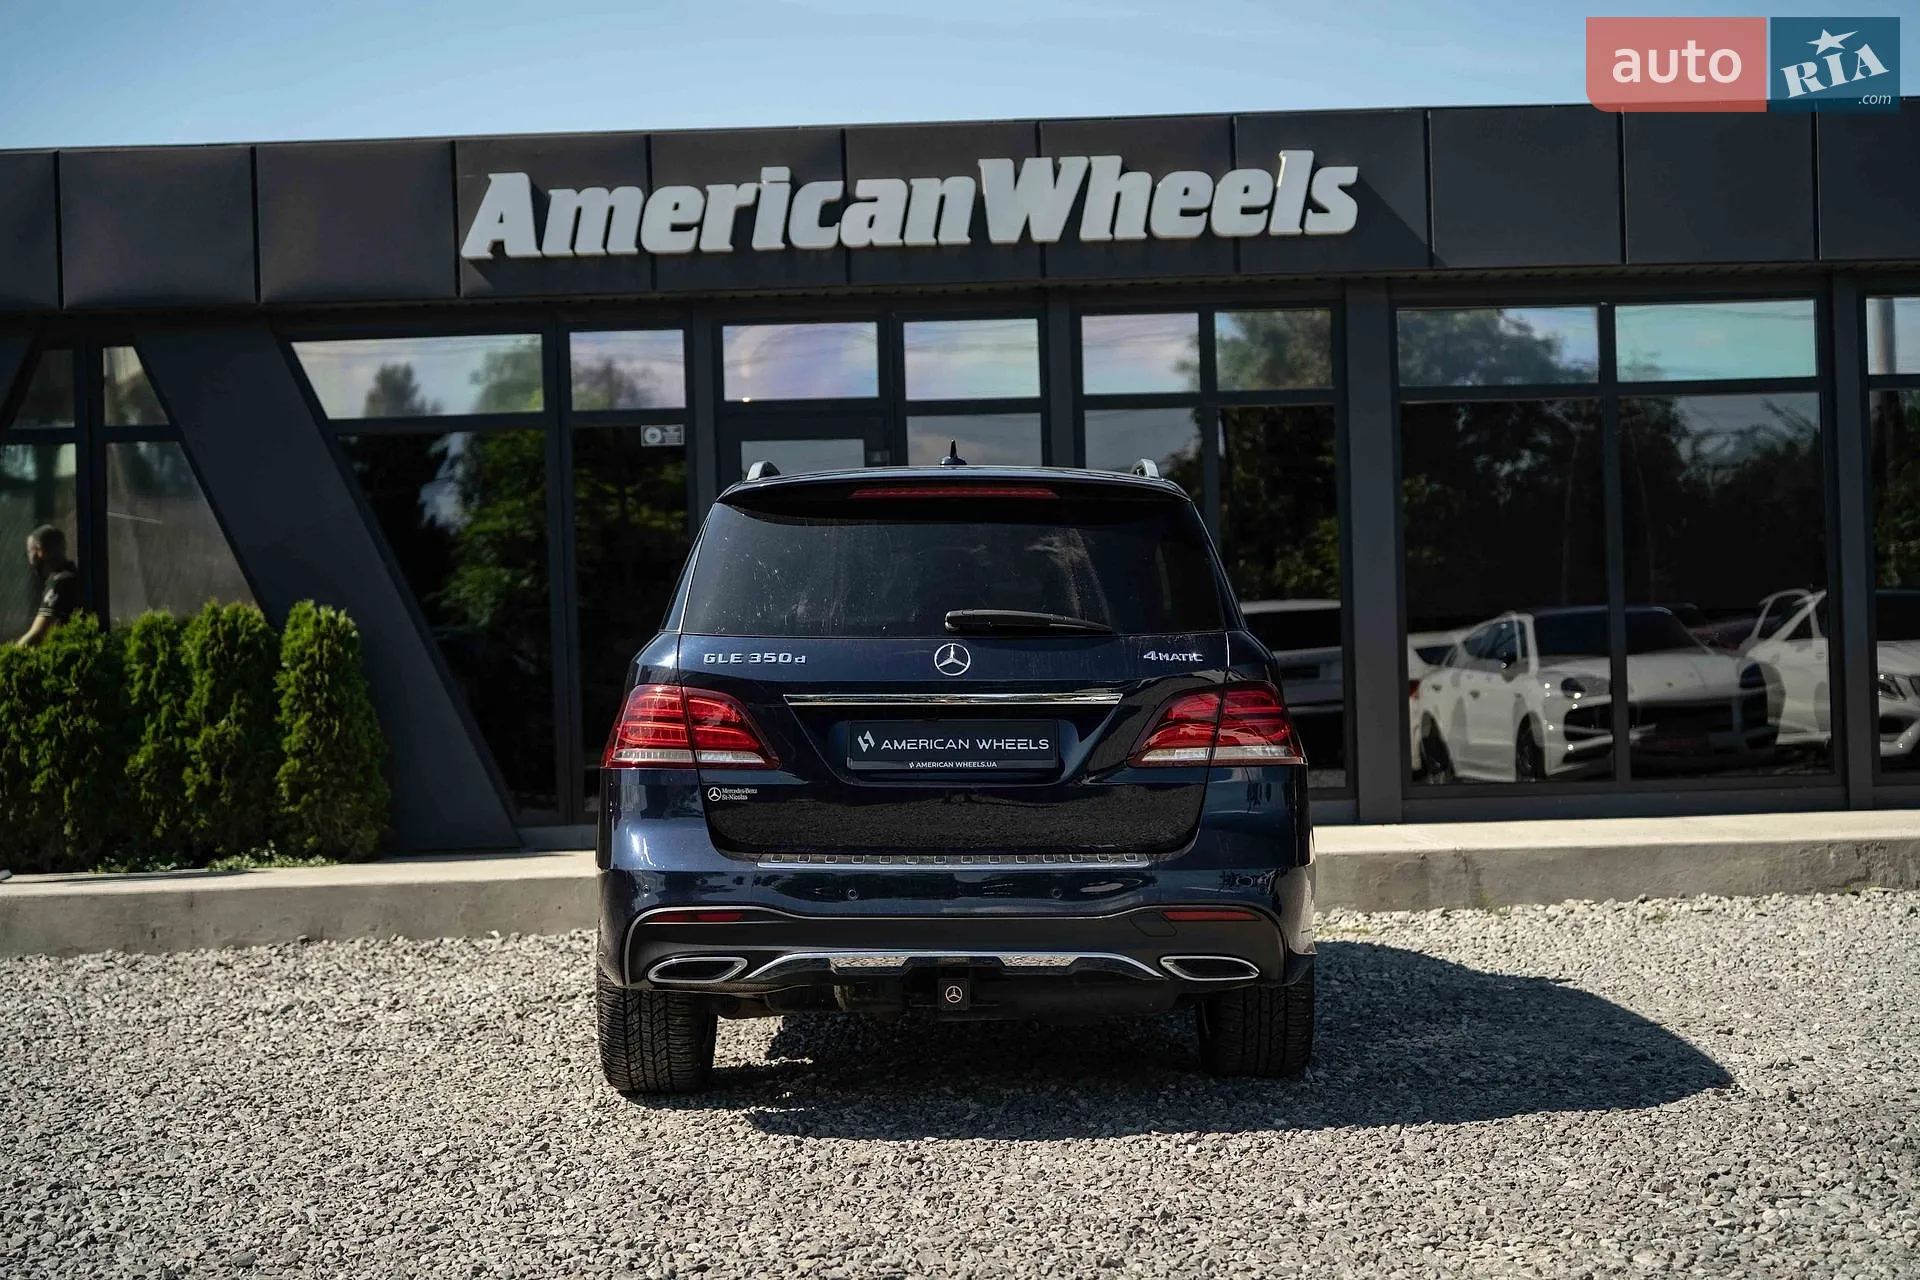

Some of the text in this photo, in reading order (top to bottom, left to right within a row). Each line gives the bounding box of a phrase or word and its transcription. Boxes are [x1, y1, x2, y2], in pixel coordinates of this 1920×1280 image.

[461, 150, 1358, 260] AmericanWheels
[703, 653, 743, 664] GLE
[1143, 650, 1204, 662] 4MATIC
[880, 739, 1050, 750] AMERICAN WHEELS
